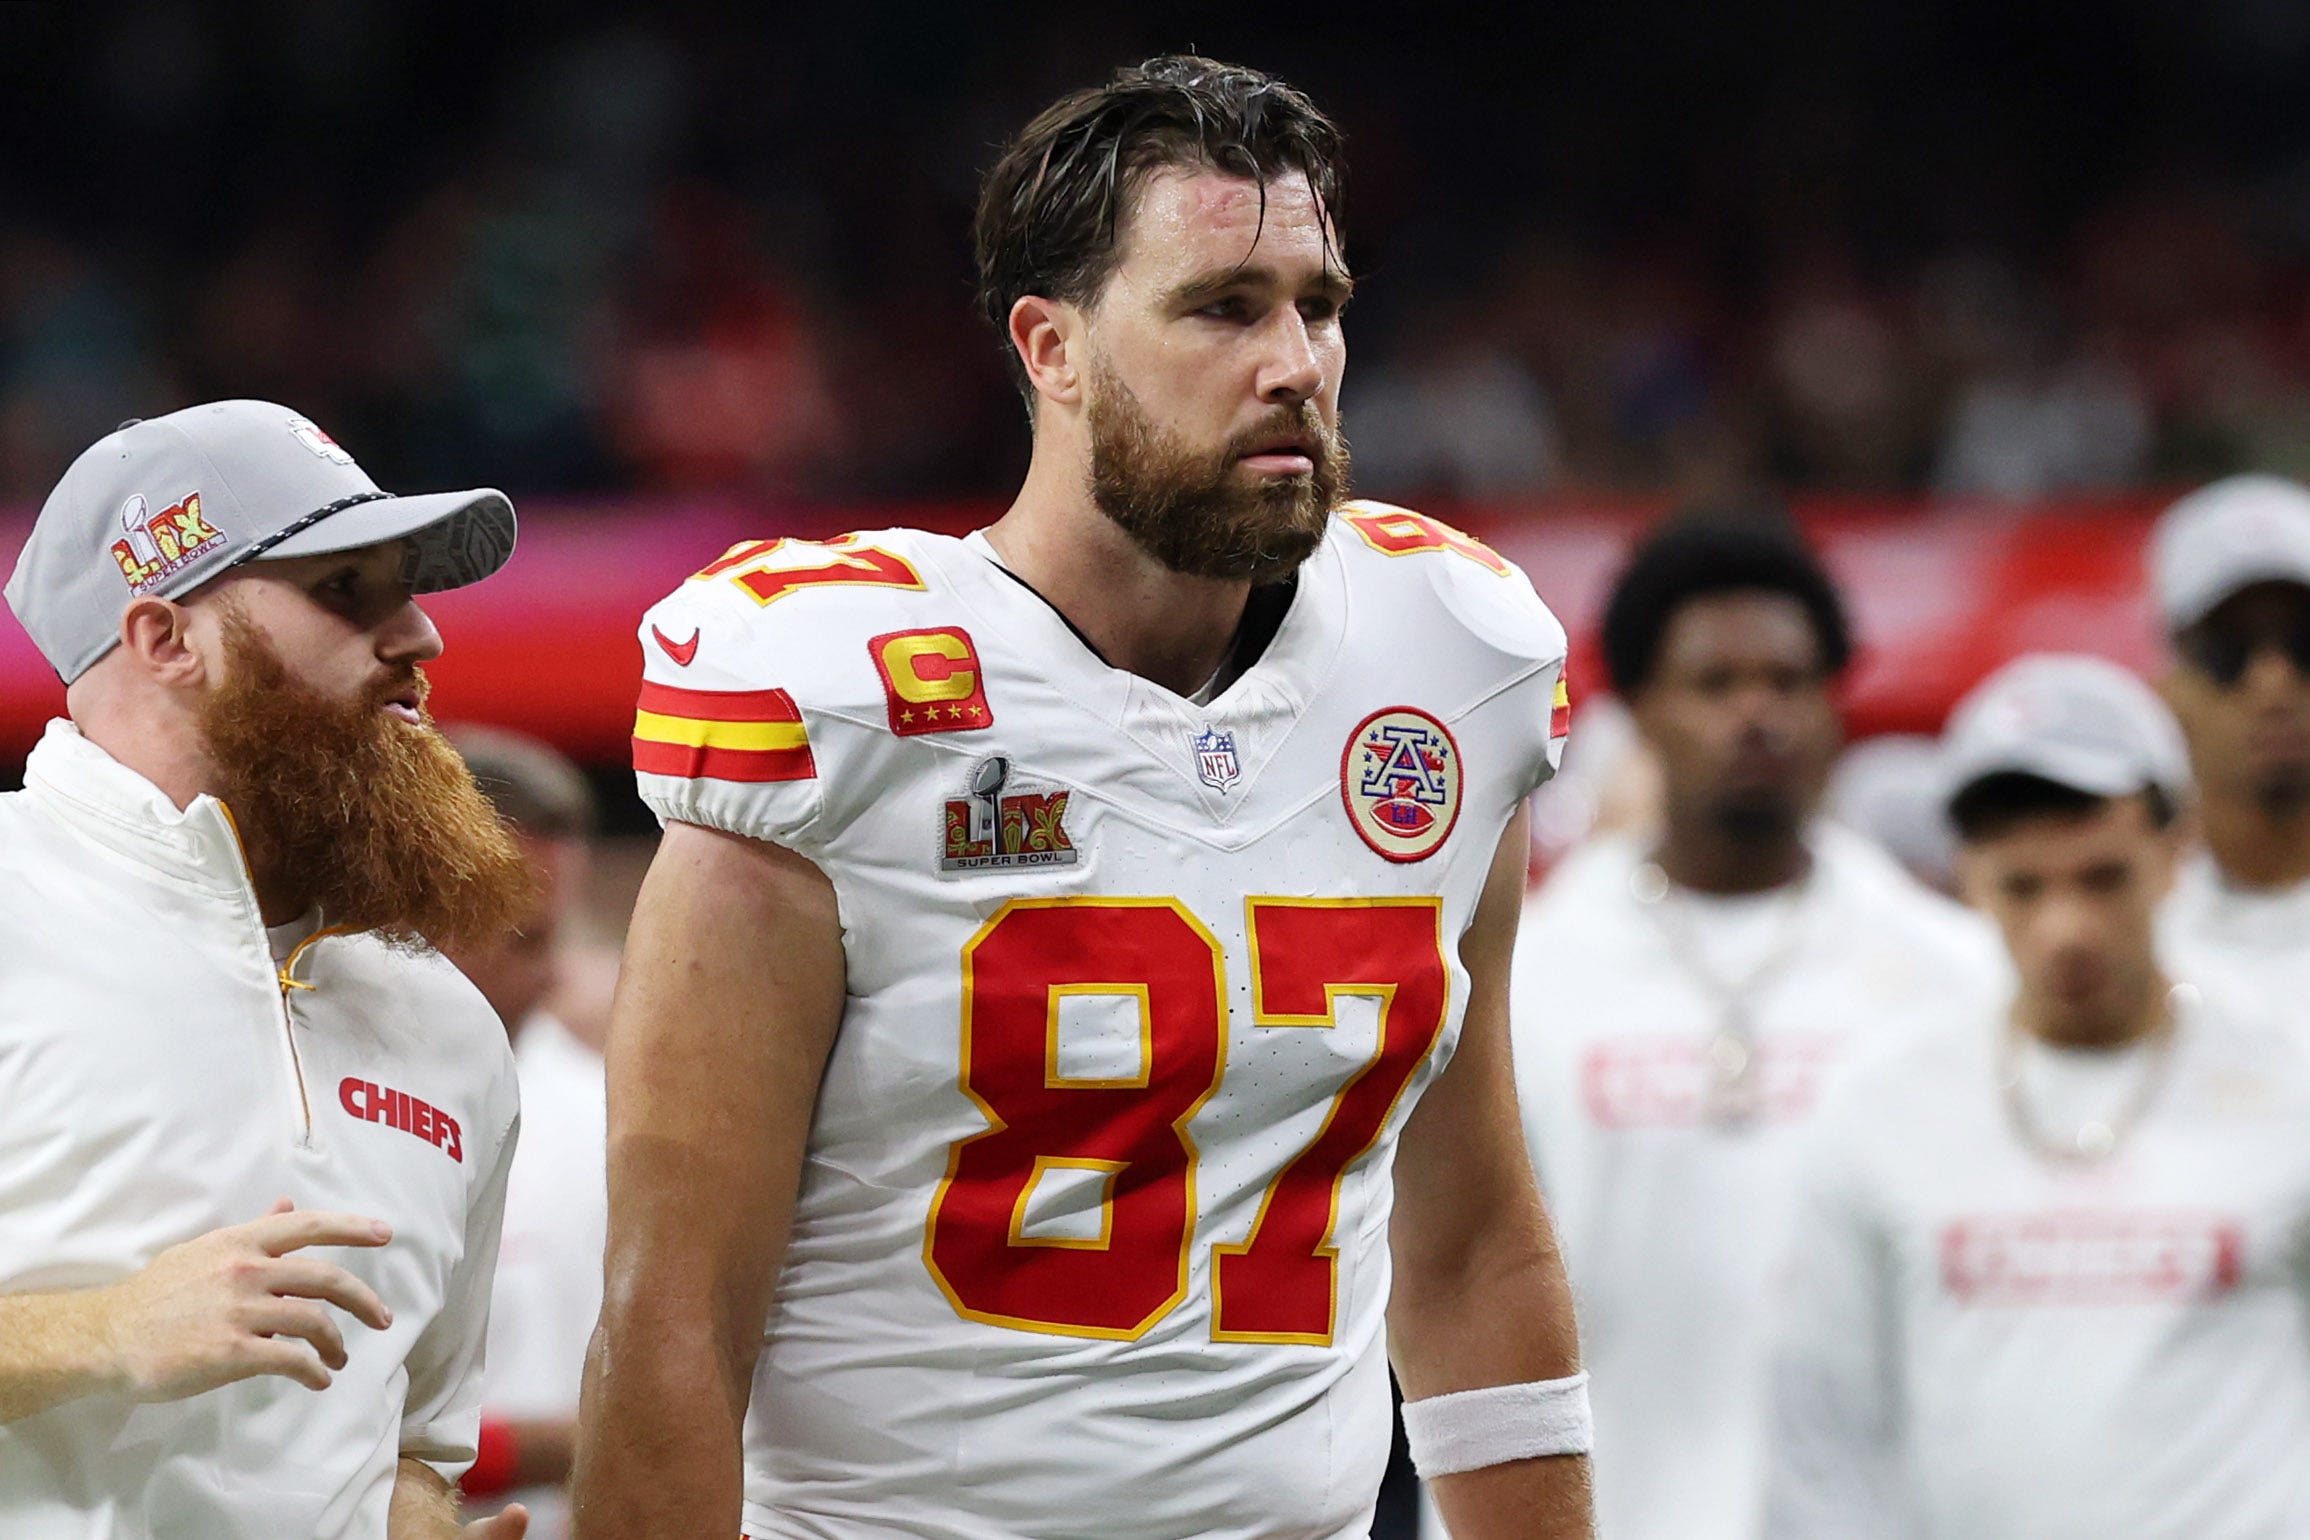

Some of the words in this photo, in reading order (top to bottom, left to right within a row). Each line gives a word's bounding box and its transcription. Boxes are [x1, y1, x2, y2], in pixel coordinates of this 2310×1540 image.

[140, 559, 180, 591] SUPER
[181, 541, 219, 563] BOWL
[882, 633, 976, 703] C
[1202, 753, 1236, 779] NFL
[957, 855, 1012, 868] SUPER
[1018, 850, 1062, 863] BOWL
[338, 1076, 463, 1164] CHIEFS
[922, 895, 1450, 1347] 87
